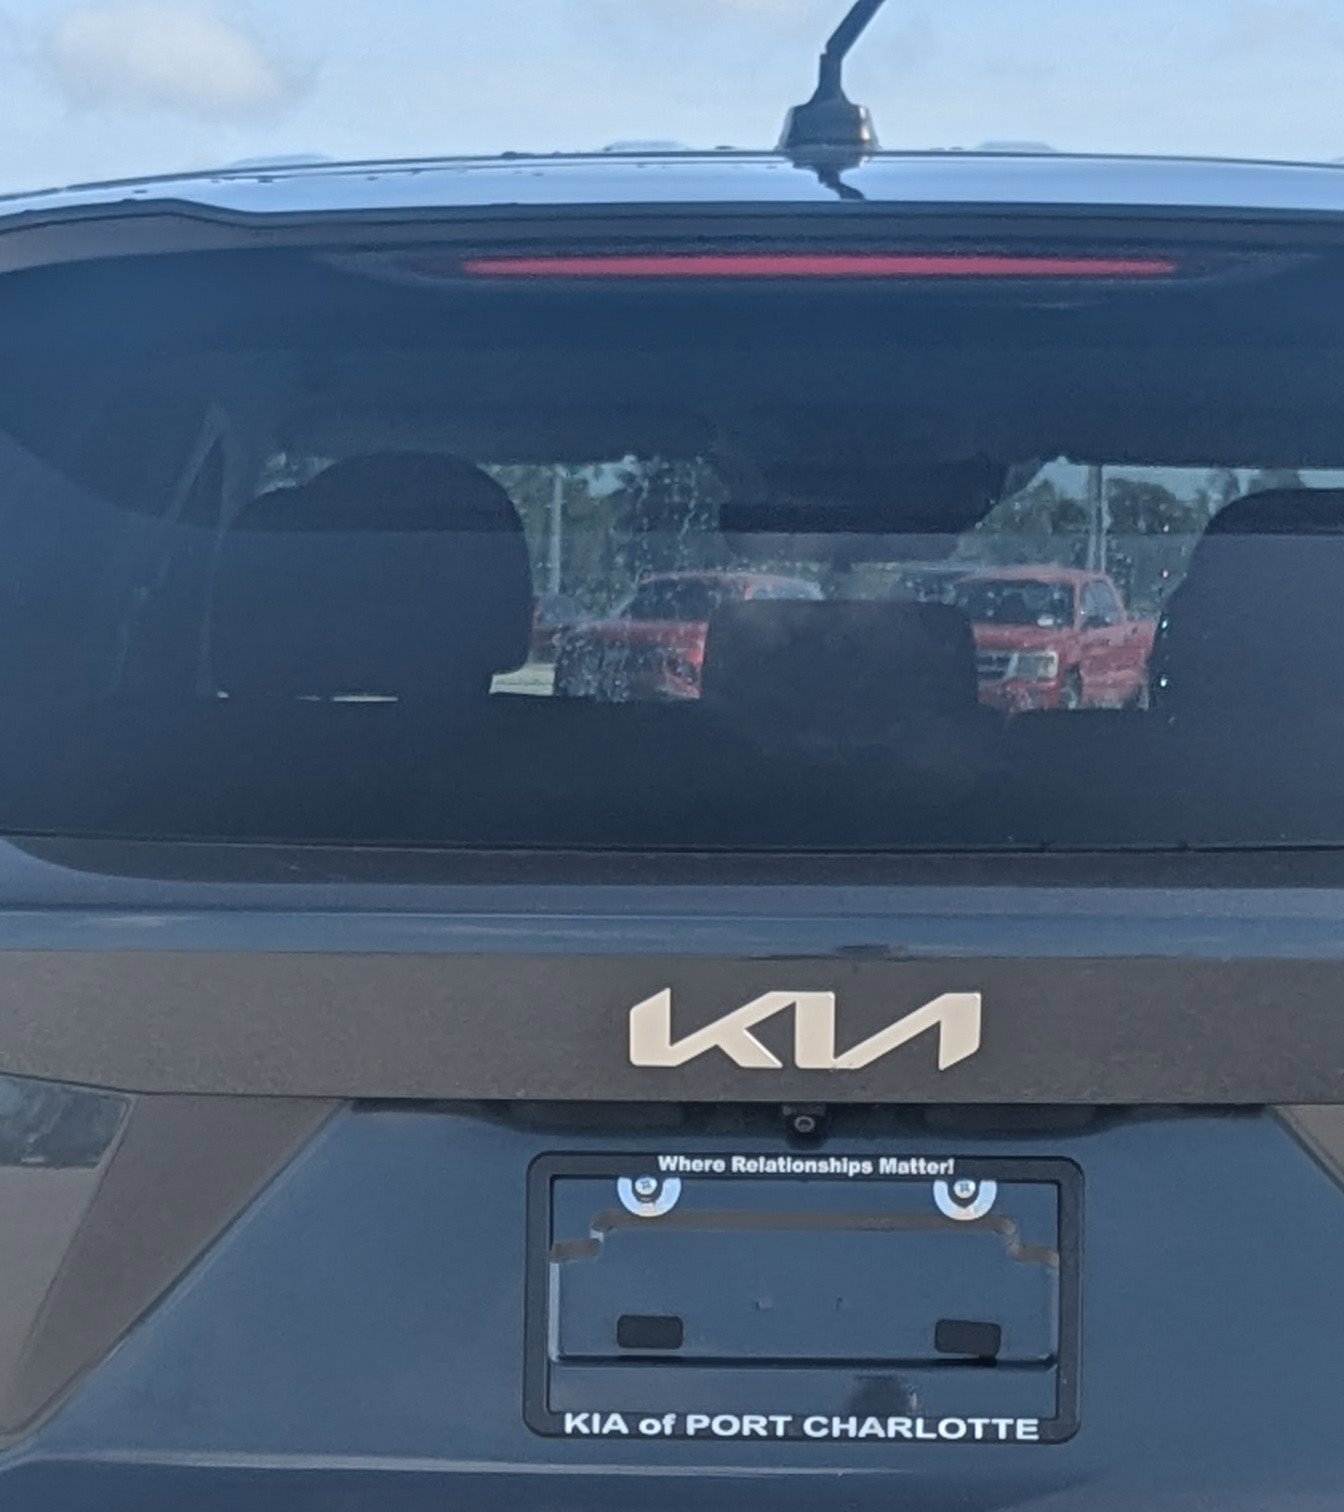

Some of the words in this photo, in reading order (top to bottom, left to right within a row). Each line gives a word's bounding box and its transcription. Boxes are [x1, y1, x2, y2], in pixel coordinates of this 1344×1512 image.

[657, 1156, 726, 1172] Where
[731, 1157, 874, 1177] Relationships
[878, 1158, 955, 1175] Matter!
[564, 1413, 629, 1435] KIA
[638, 1414, 676, 1435] of
[686, 1414, 792, 1437] PORT
[802, 1416, 1040, 1440] CHARLOTTE
